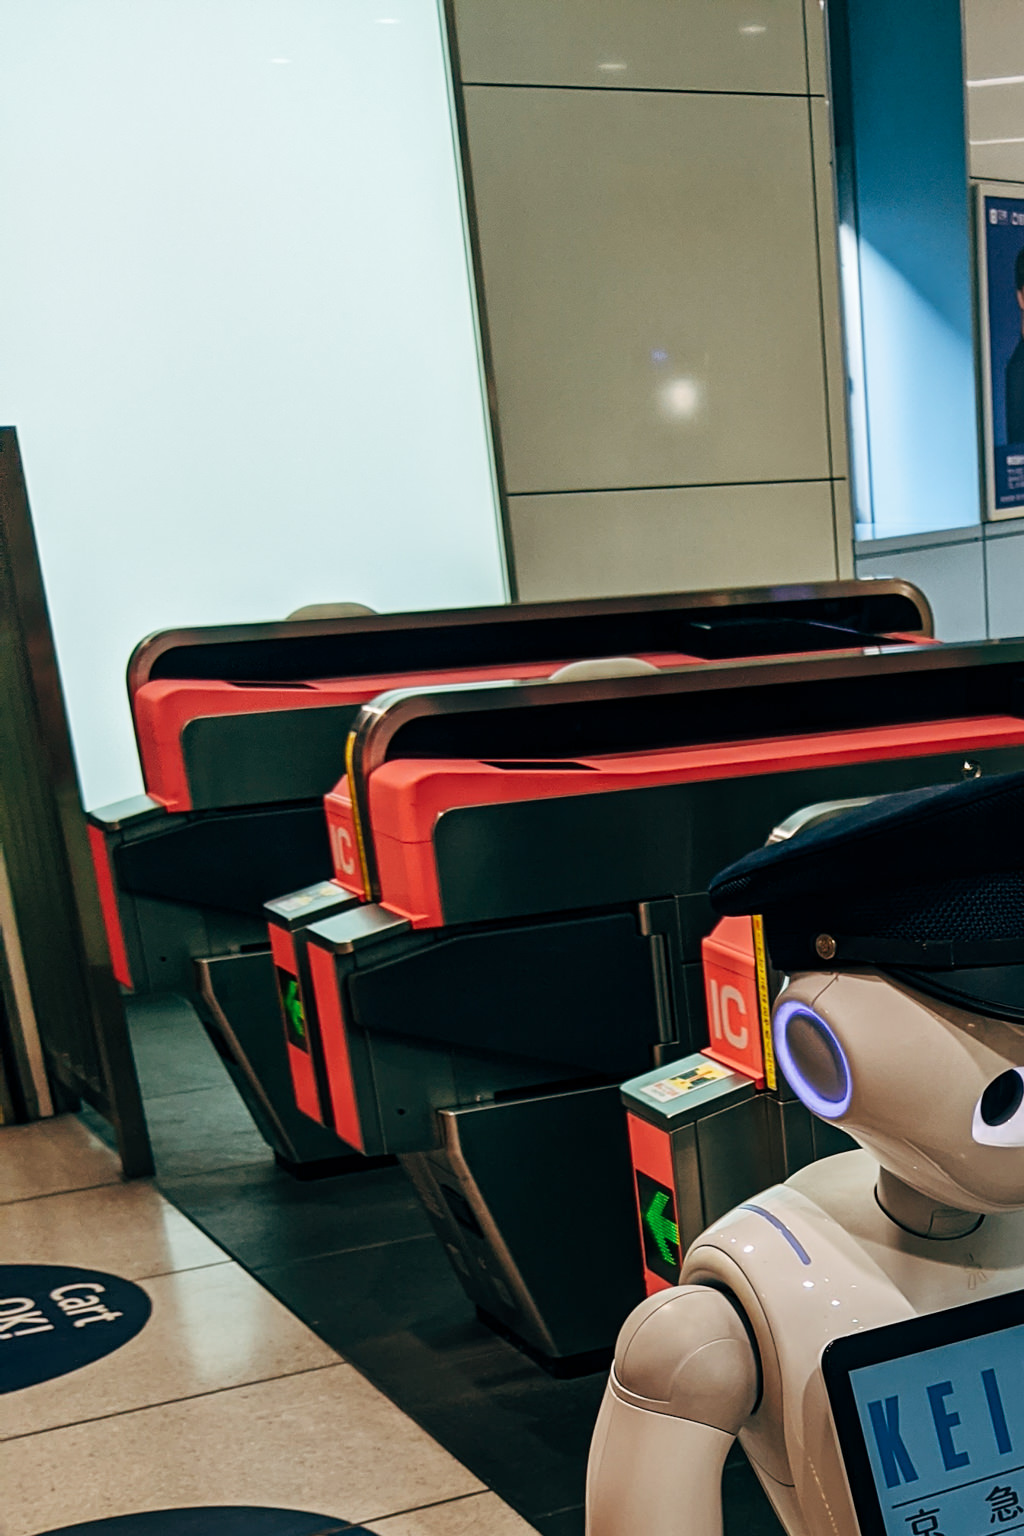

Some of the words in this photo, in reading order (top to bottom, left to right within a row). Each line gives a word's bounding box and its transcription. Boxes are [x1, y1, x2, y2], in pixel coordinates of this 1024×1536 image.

[329, 824, 355, 875] IC
[710, 979, 748, 1050] IC
[49, 1283, 123, 1328] Cart
